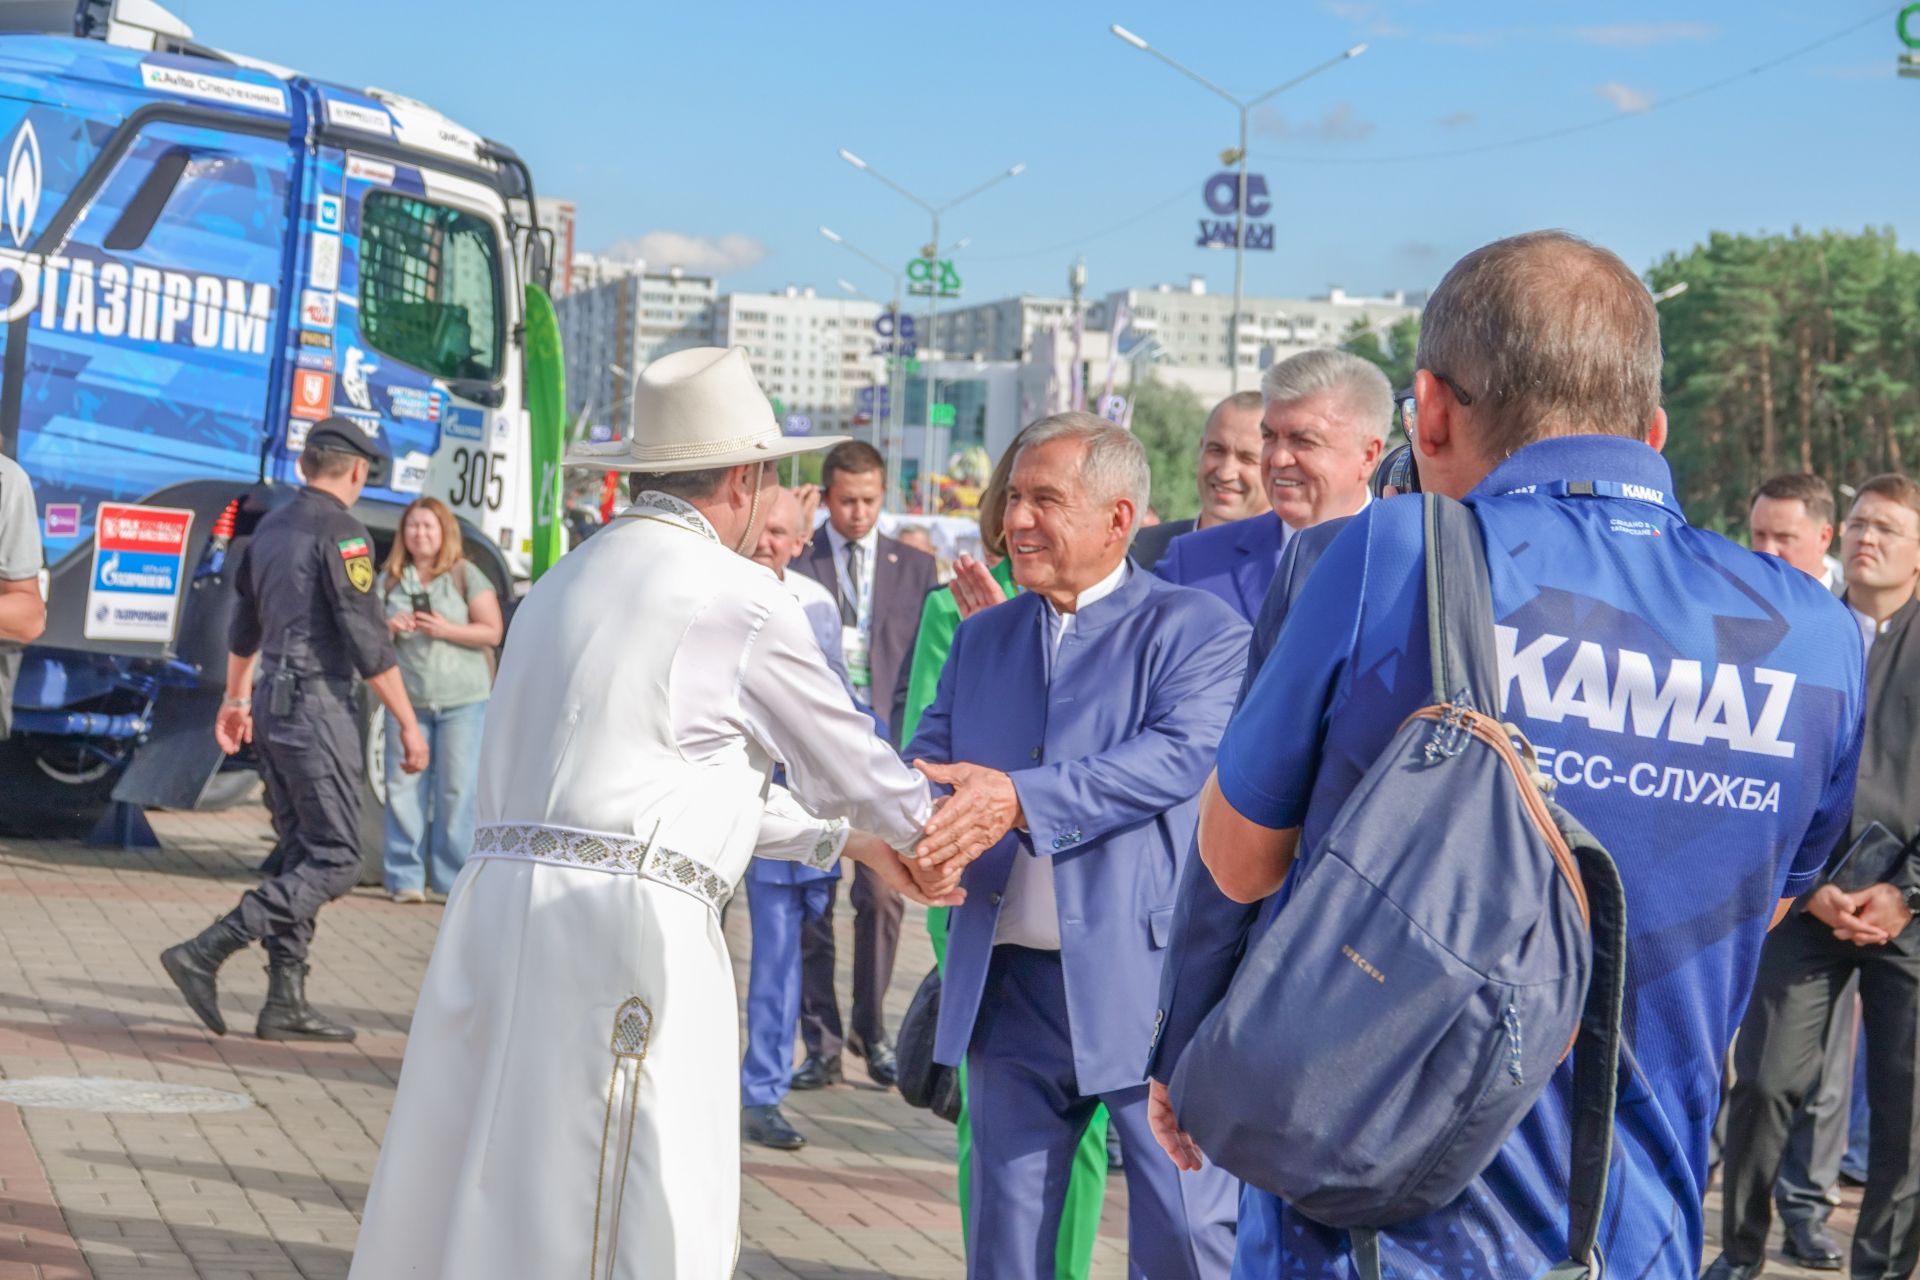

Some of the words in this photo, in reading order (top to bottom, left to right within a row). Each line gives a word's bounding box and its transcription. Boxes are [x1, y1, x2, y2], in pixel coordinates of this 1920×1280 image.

[40, 255, 272, 354] ГАЗПРОМ
[449, 447, 507, 513] 305
[1621, 482, 1665, 505] KAMAZ
[1494, 624, 1797, 759] KAMAZ
[1511, 741, 1781, 813] ЕСС-СЛУЖБА
